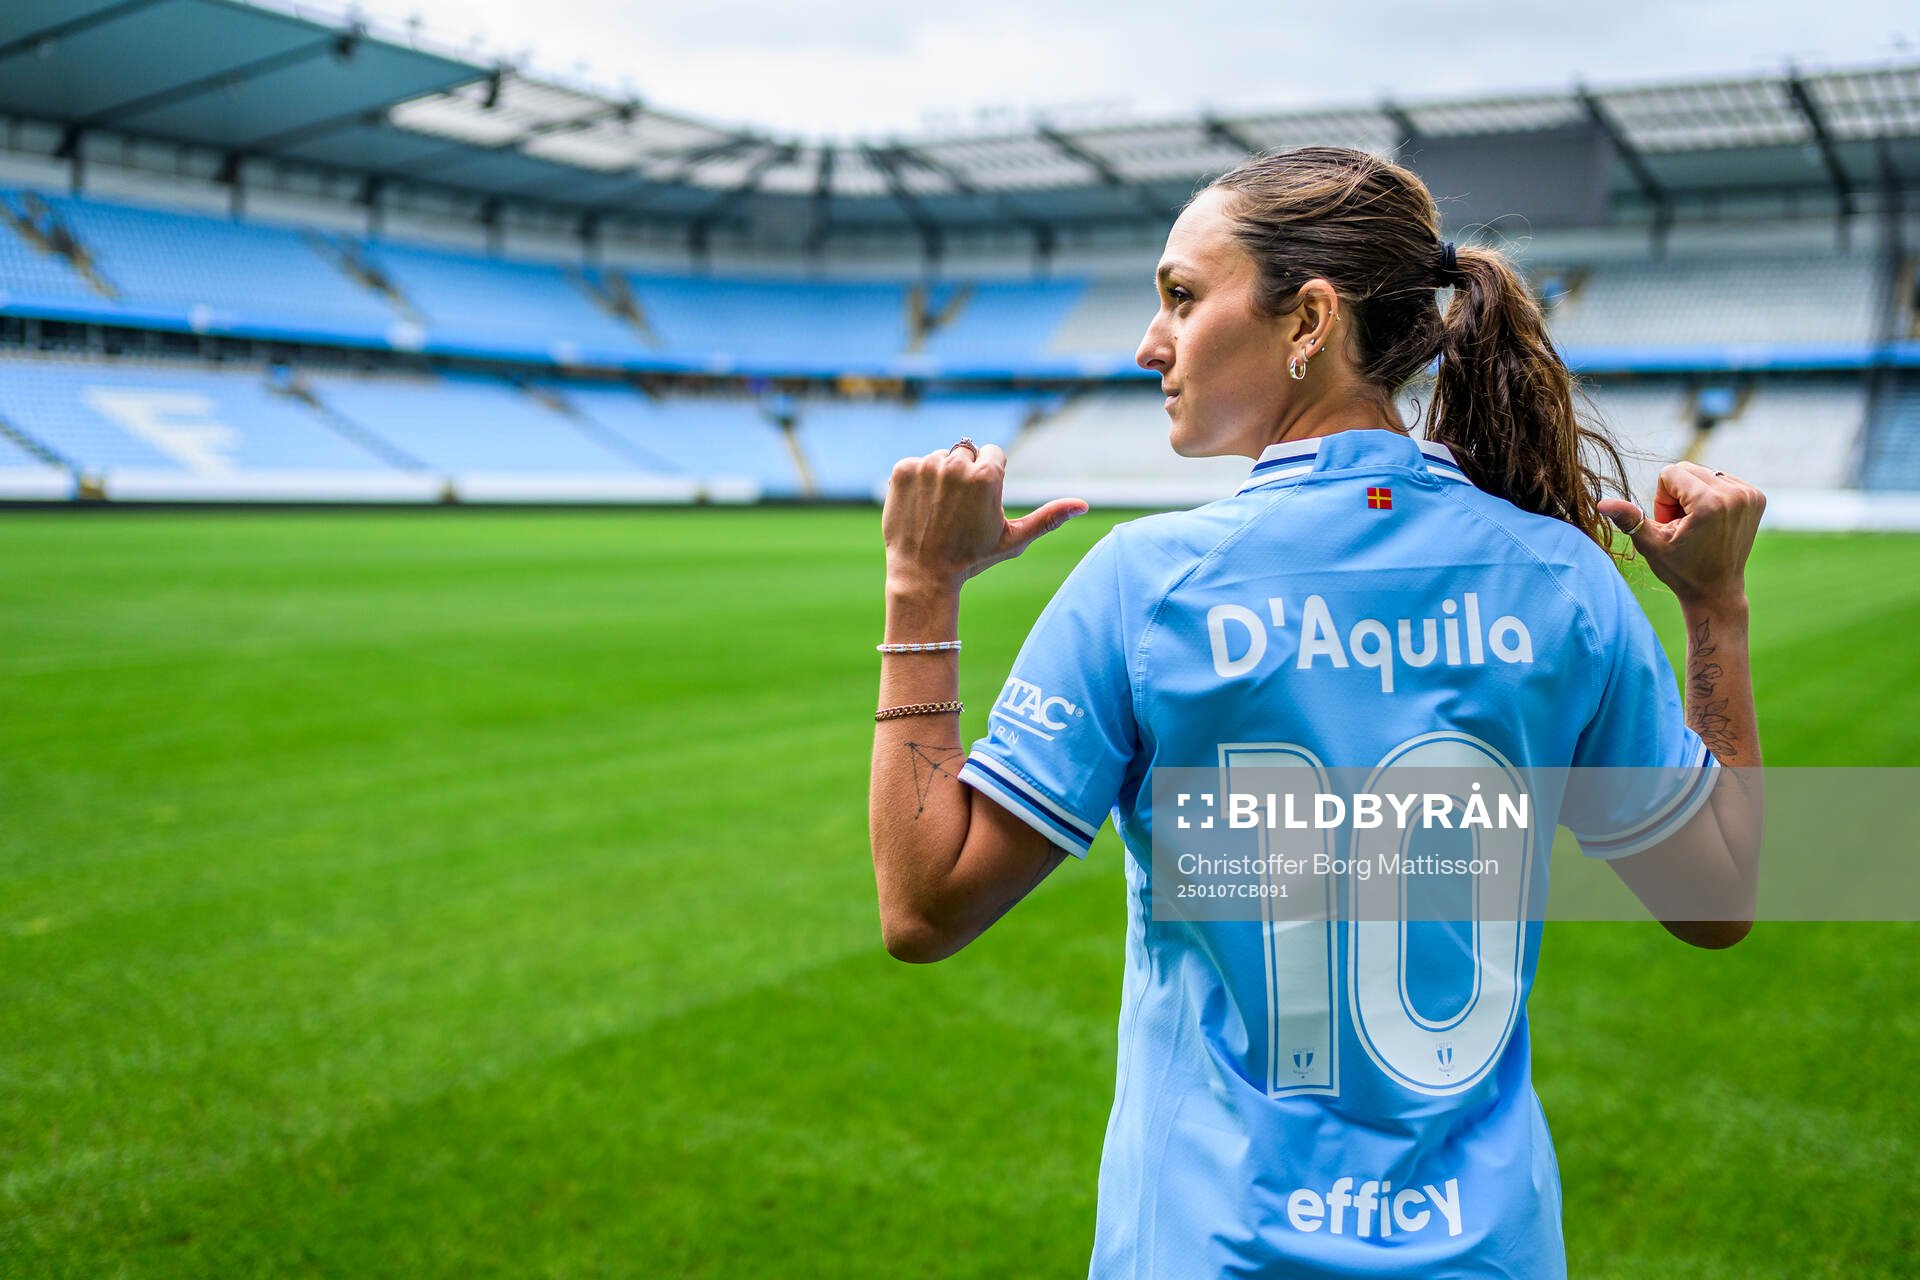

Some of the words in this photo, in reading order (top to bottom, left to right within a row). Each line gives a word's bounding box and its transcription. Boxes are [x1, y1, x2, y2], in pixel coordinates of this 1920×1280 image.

[1207, 593, 1534, 693] D'Aquila
[1217, 730, 1535, 1098] 10
[1287, 1177, 1463, 1238] efficy
